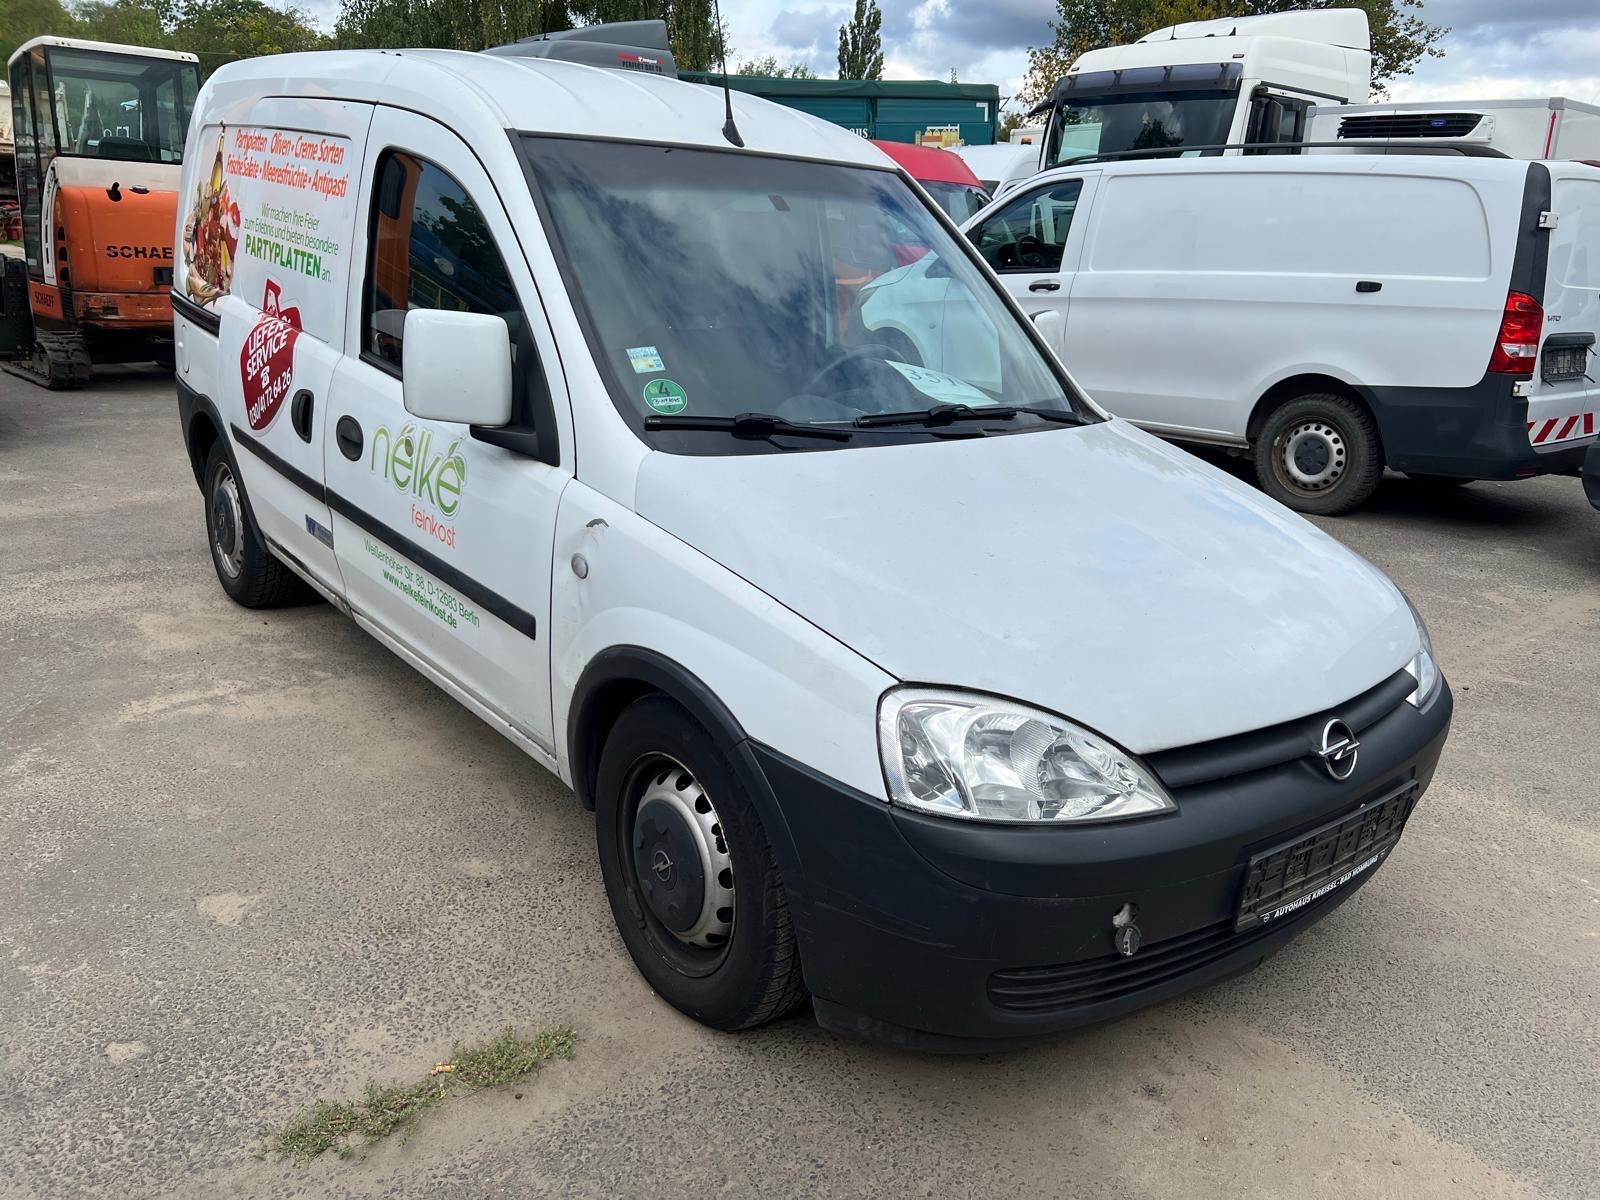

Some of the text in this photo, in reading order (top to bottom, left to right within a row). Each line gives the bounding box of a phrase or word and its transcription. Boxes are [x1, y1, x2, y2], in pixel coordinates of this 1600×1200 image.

[270, 132, 291, 156] Oliven
[295, 136, 317, 160] Creme
[318, 139, 345, 165] Sorten
[261, 160, 308, 189] Meeresfrüchte
[311, 169, 349, 200] Antipasti
[261, 202, 321, 231] Wir machen Ihre Feier
[244, 218, 339, 256] zum Erlebnis und bieten besondere
[245, 234, 332, 283] PARTYPLATTEN an.
[246, 328, 293, 381] SERVICE
[282, 367, 292, 391] 26
[659, 381, 671, 397] 4
[411, 503, 456, 550] feinkost
[383, 568, 457, 629] www.nelkefeinkost.de
[458, 602, 480, 629] Berlin
[1274, 894, 1311, 919] AUTOHAUS
